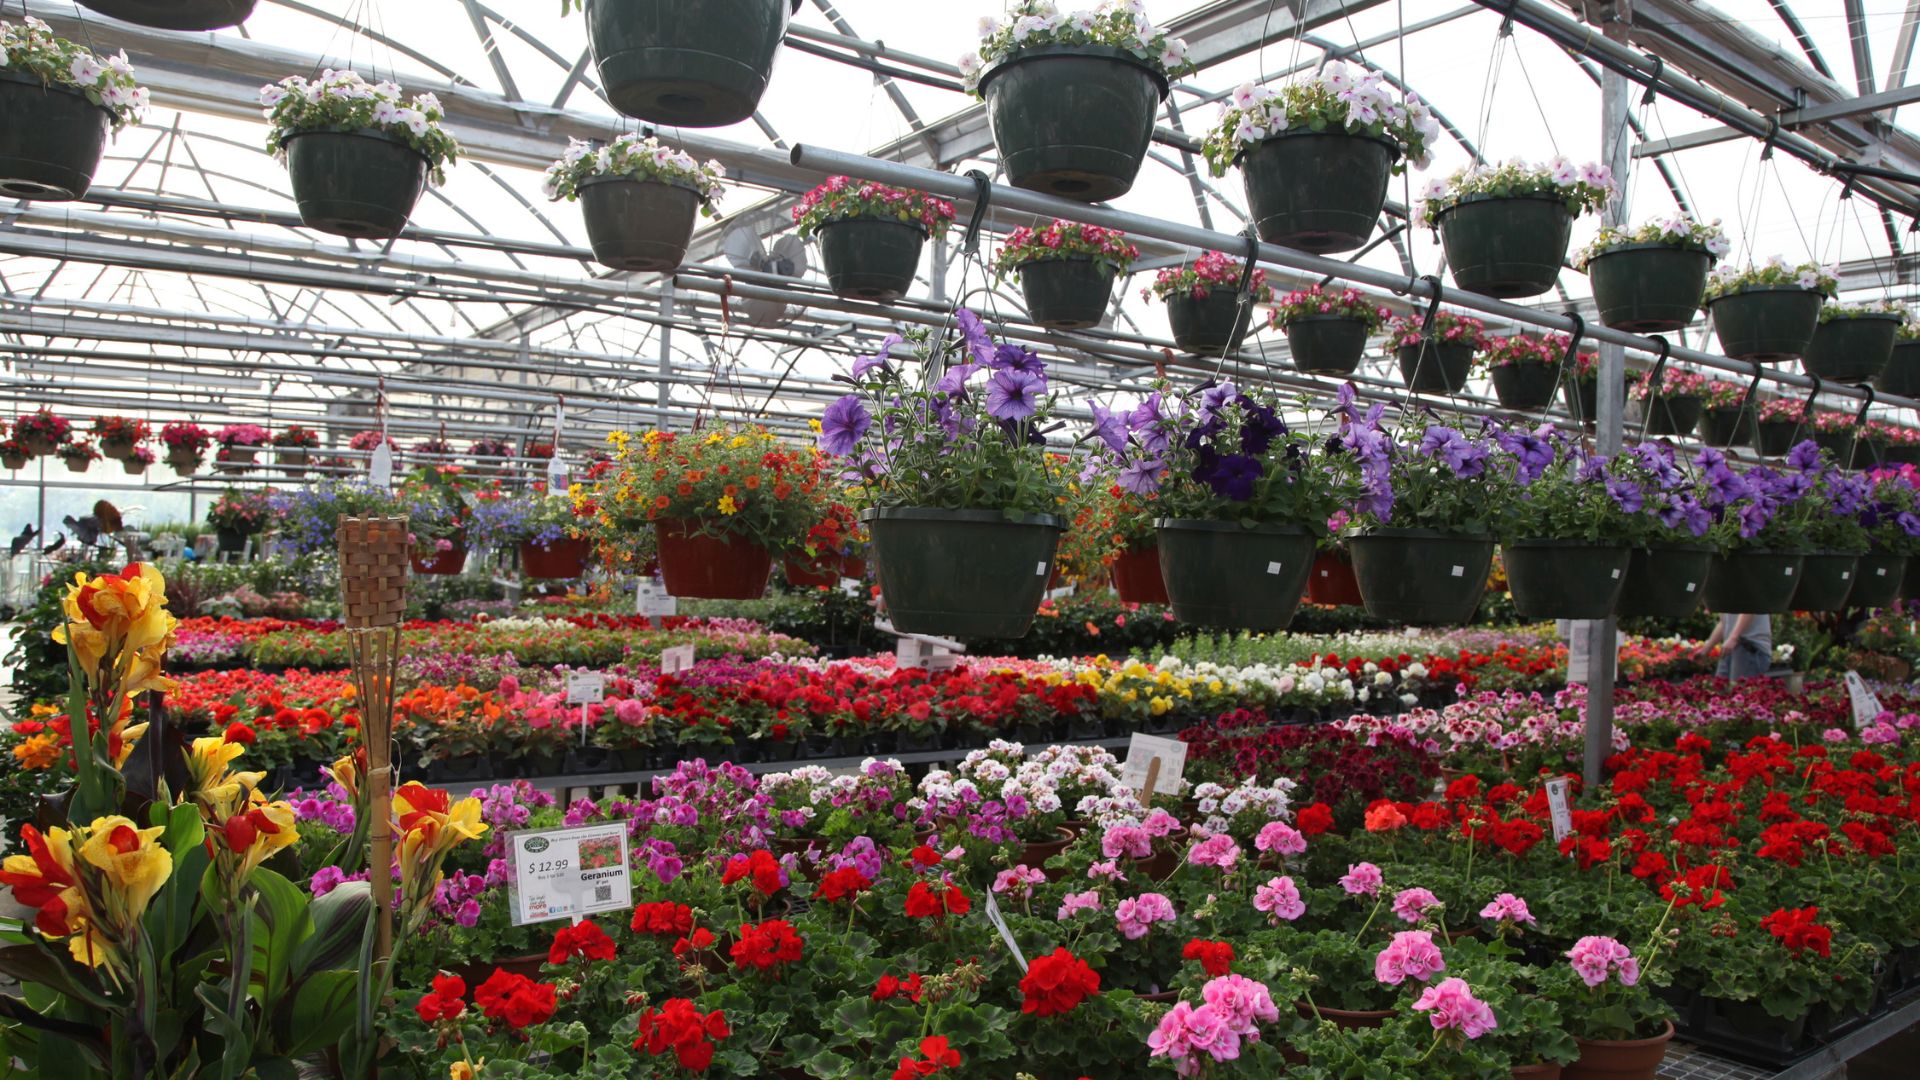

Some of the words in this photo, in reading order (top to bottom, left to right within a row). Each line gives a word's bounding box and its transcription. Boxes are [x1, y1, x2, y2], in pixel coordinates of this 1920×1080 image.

[528, 861, 536, 874] $
[539, 859, 569, 873] 12.99
[580, 869, 623, 881] Geranium
